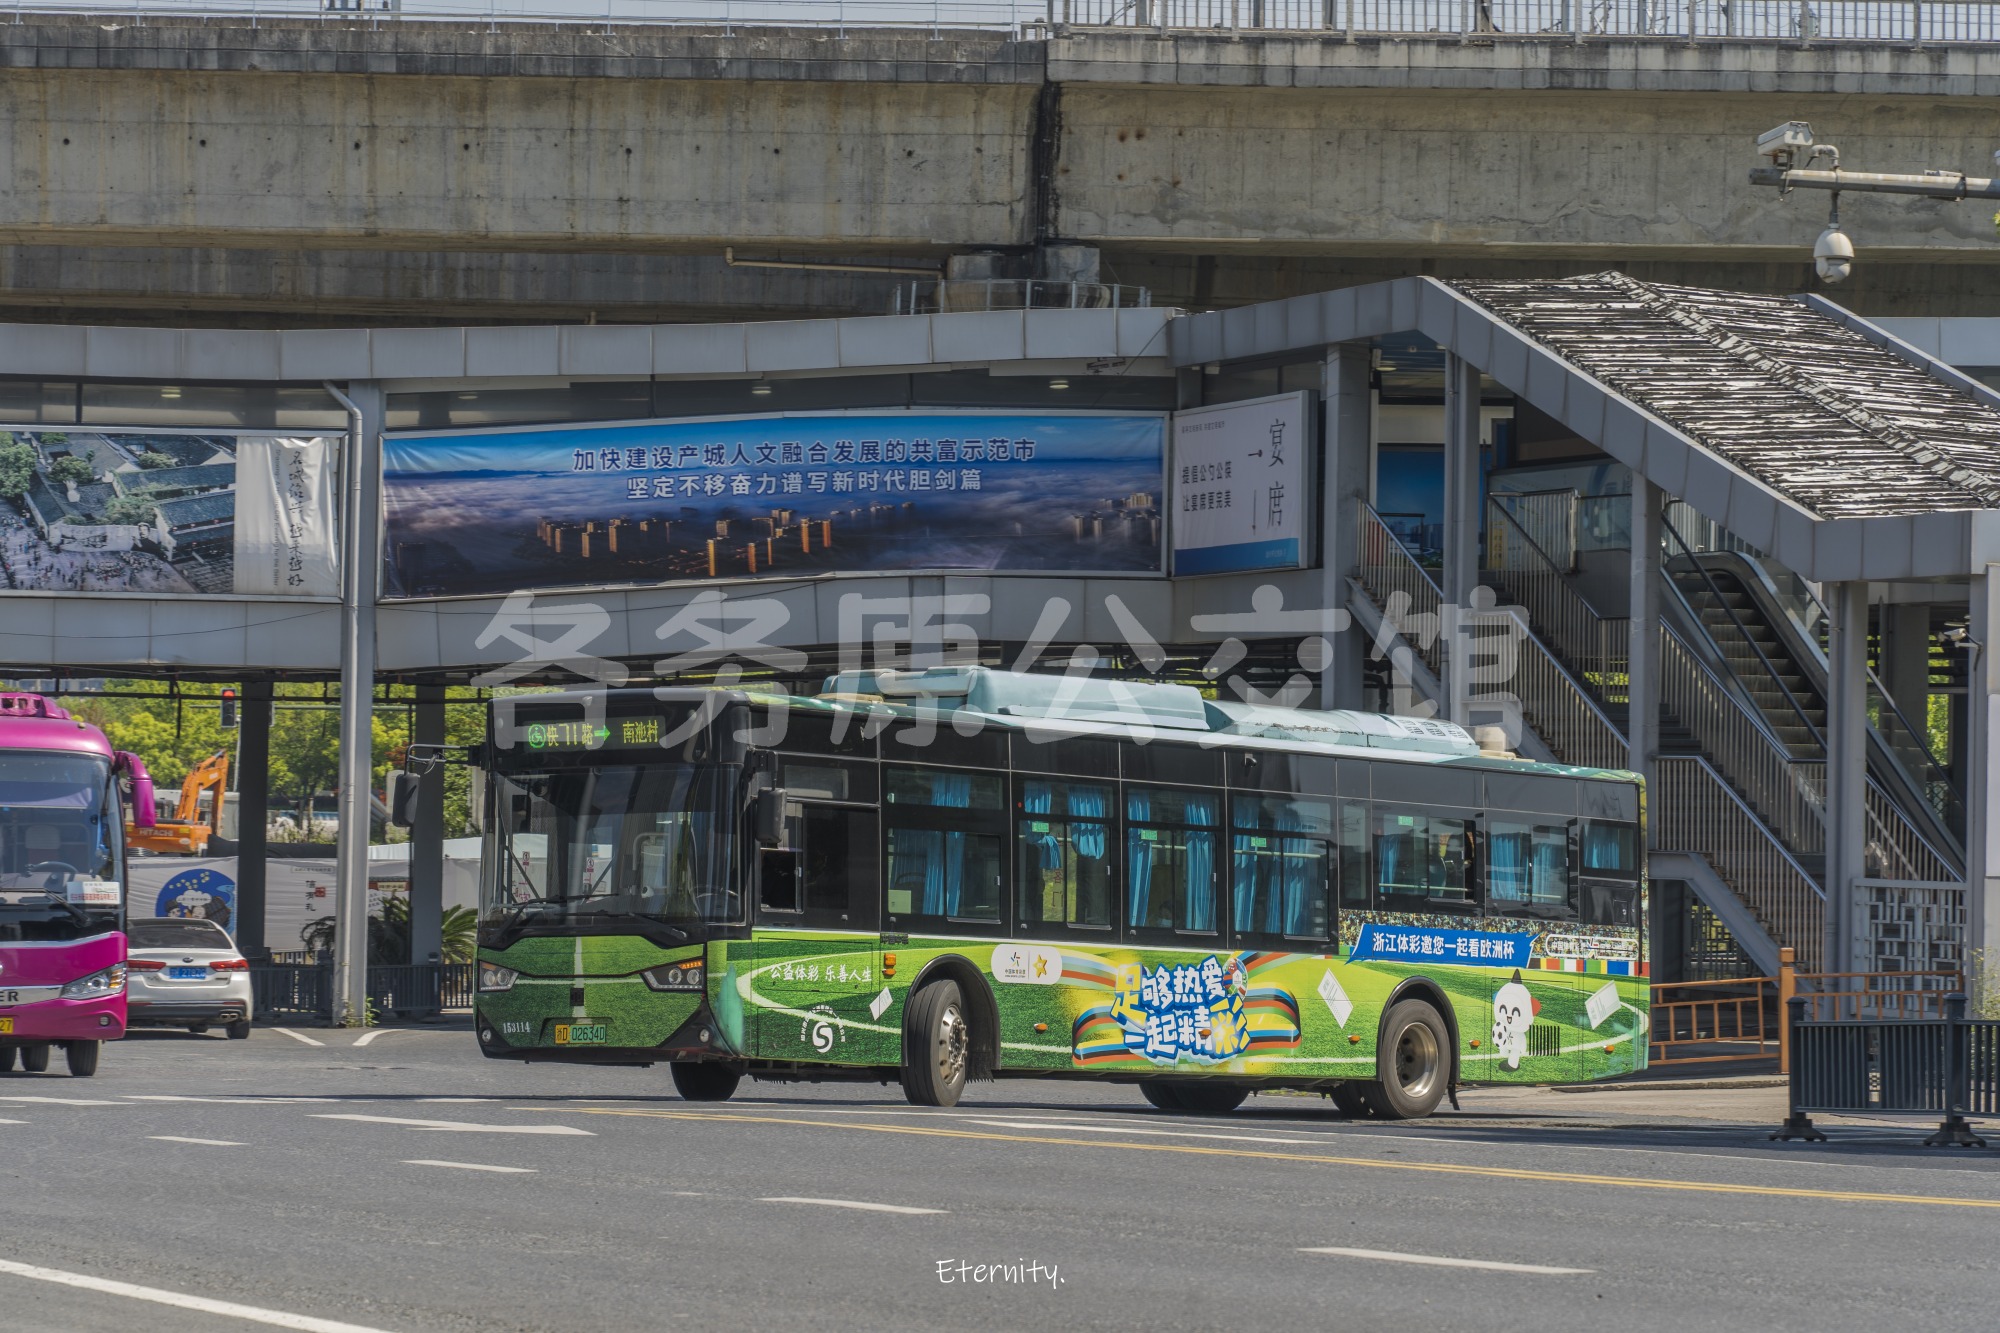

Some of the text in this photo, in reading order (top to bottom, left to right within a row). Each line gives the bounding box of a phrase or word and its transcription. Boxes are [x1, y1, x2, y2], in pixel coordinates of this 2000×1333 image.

[573, 439, 1035, 471] 加快建设产城人文融合发展的共富示范市
[627, 469, 982, 499] 坚定不移奋力谱写新时代胆剑篇
[1182, 461, 1232, 484] 提倡公勺公筷
[1183, 490, 1232, 511] 让宴席更完美
[622, 720, 659, 744] 南池村
[140, 829, 174, 837] HITACHI
[1372, 932, 1516, 960] 浙江体彩邀您一起看欧洲杯
[770, 963, 872, 983] 公益体彩 乐善人生
[503, 1022, 531, 1033] 153114
[1125, 995, 1250, 1056] 一起精彩
